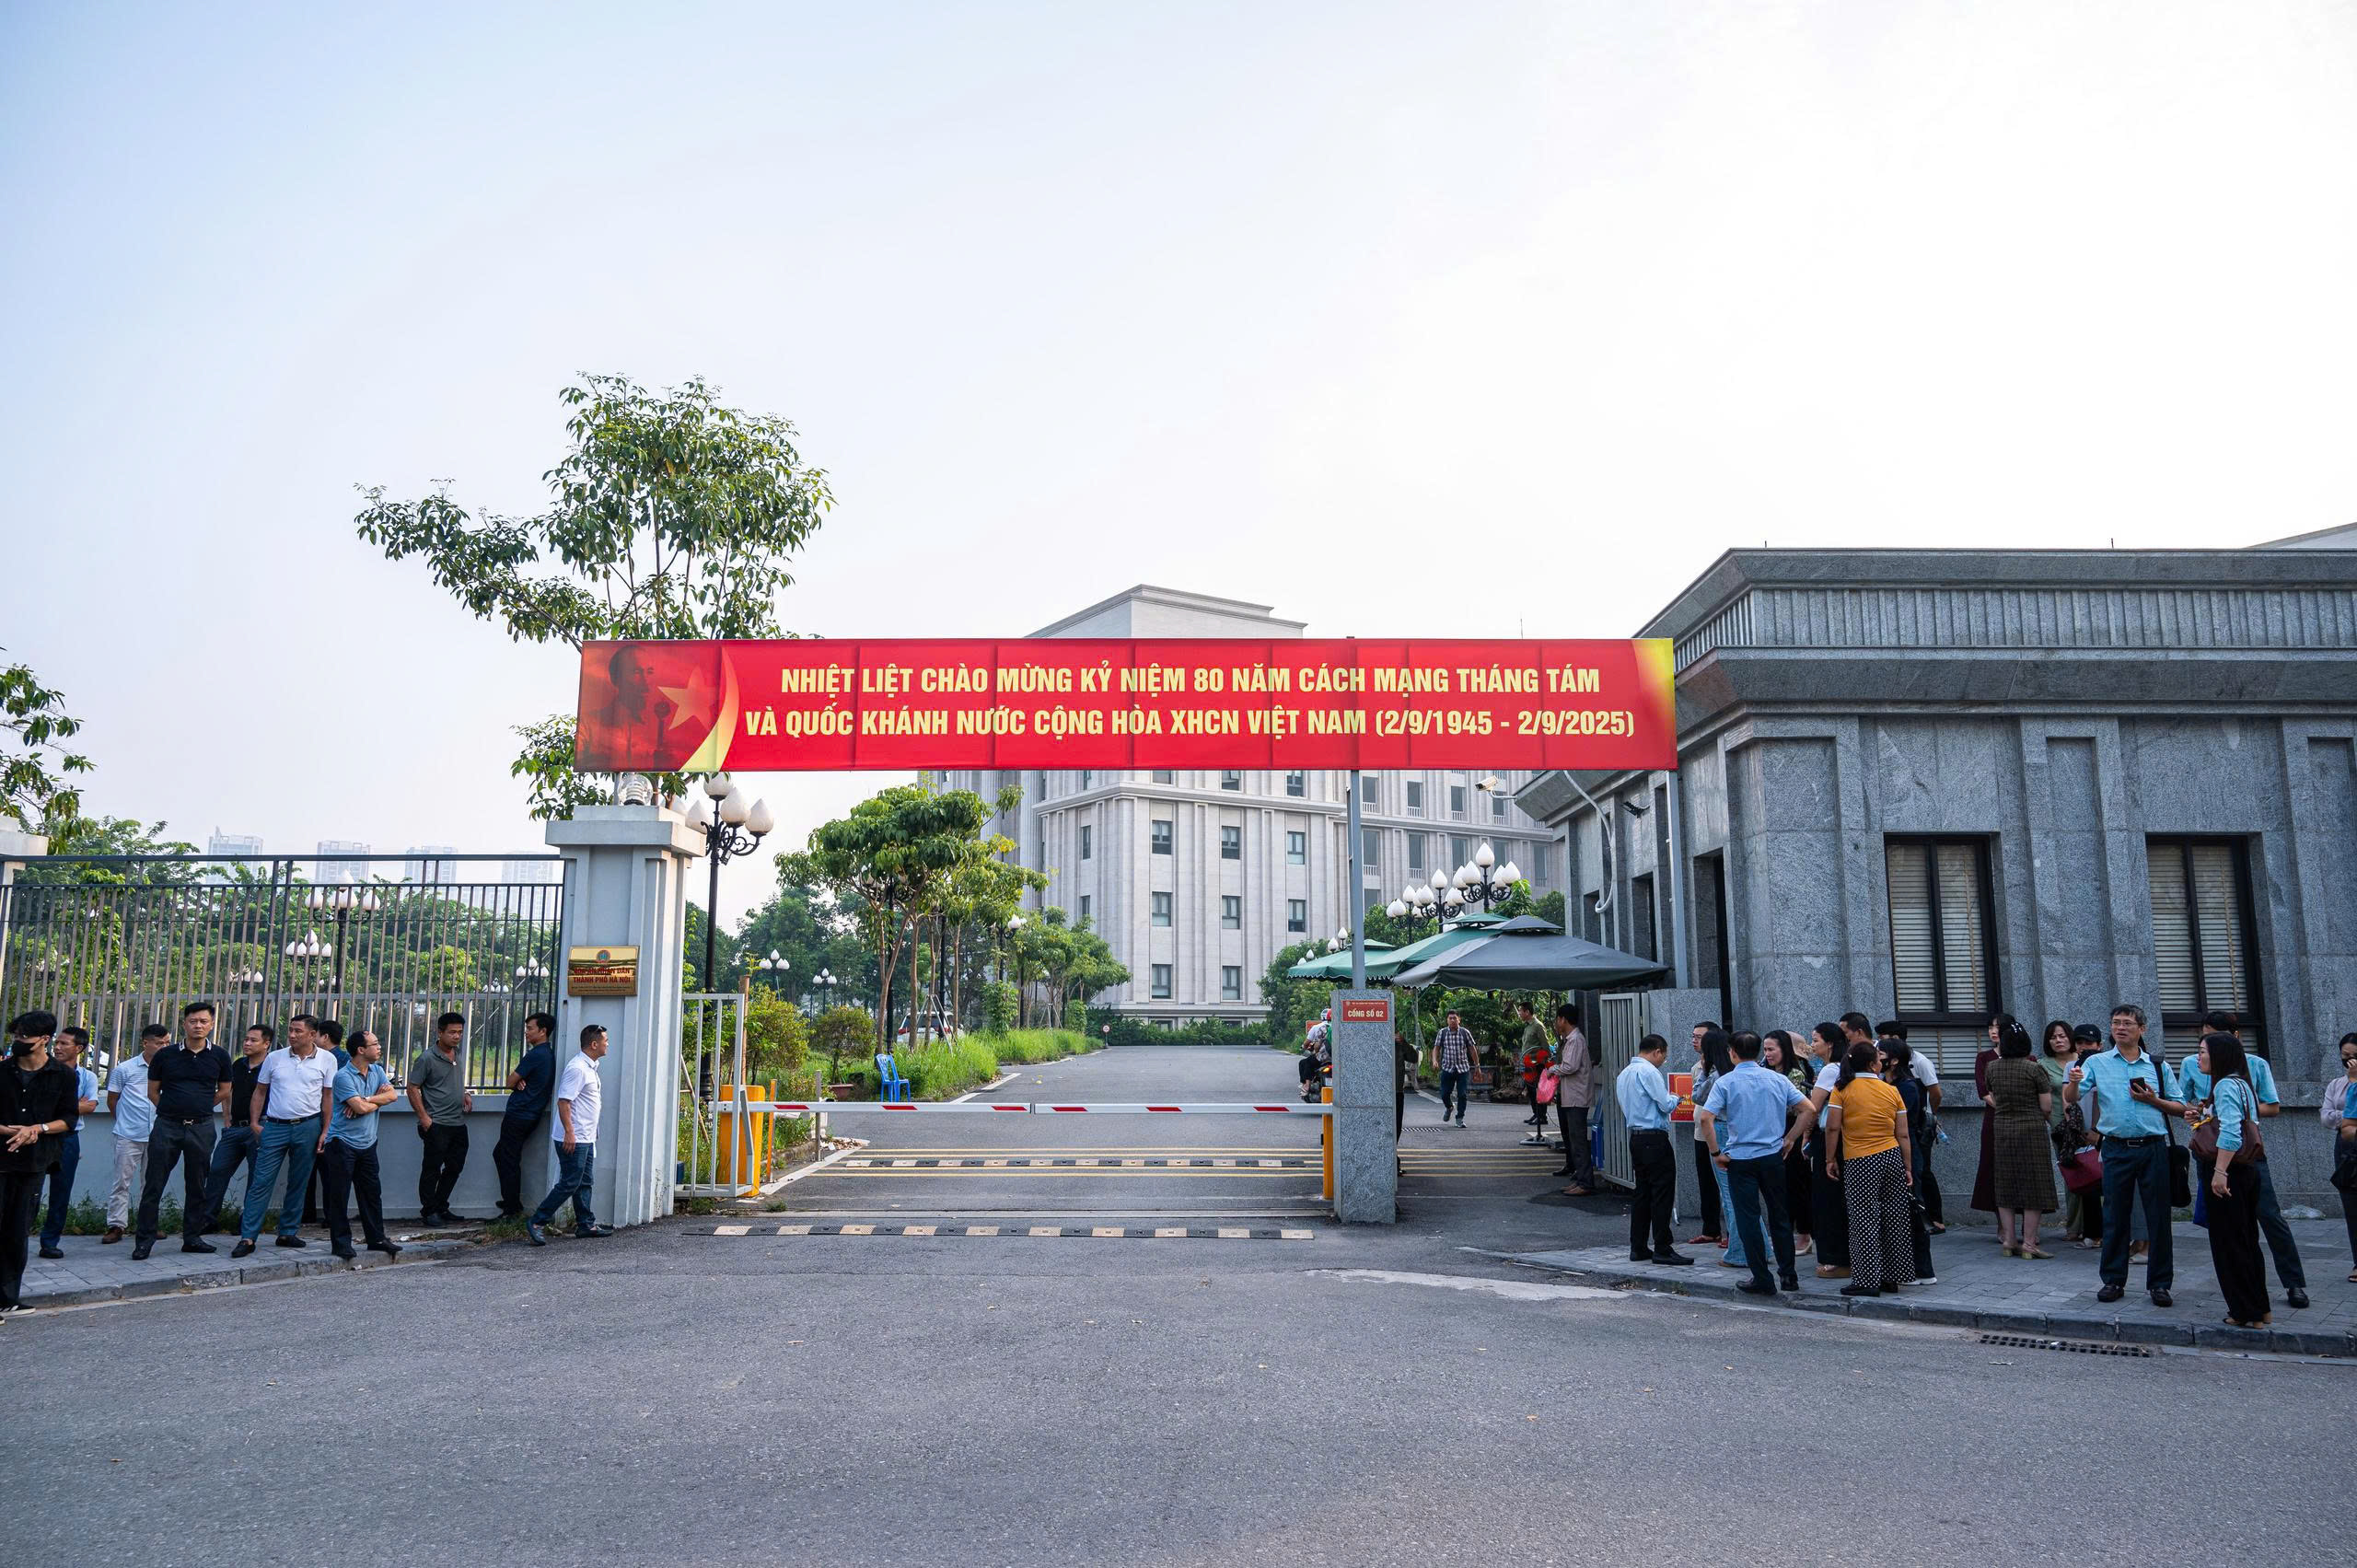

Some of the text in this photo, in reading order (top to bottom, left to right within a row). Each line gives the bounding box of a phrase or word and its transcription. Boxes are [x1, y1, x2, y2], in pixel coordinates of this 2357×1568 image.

[782, 659, 1600, 699] NHIỆT LIỆT CHÀO MỪNG KỶ NIỆM 80 NĂM CÁCH MẠNG THÁNG TÁM
[746, 705, 778, 736] VÀ
[786, 703, 853, 738] QUỐC
[862, 704, 948, 736] KHÁNH
[957, 704, 1026, 736] NƯỚC
[1035, 704, 1104, 740] CỘNG
[1112, 703, 1163, 735] HÒA
[1170, 710, 1239, 735] XHCN
[1248, 704, 1300, 740] VIỆT
[1307, 710, 1366, 735] NAM
[1376, 709, 1492, 738] (2/9/1945
[1518, 709, 1634, 738] 2/9/2025)
